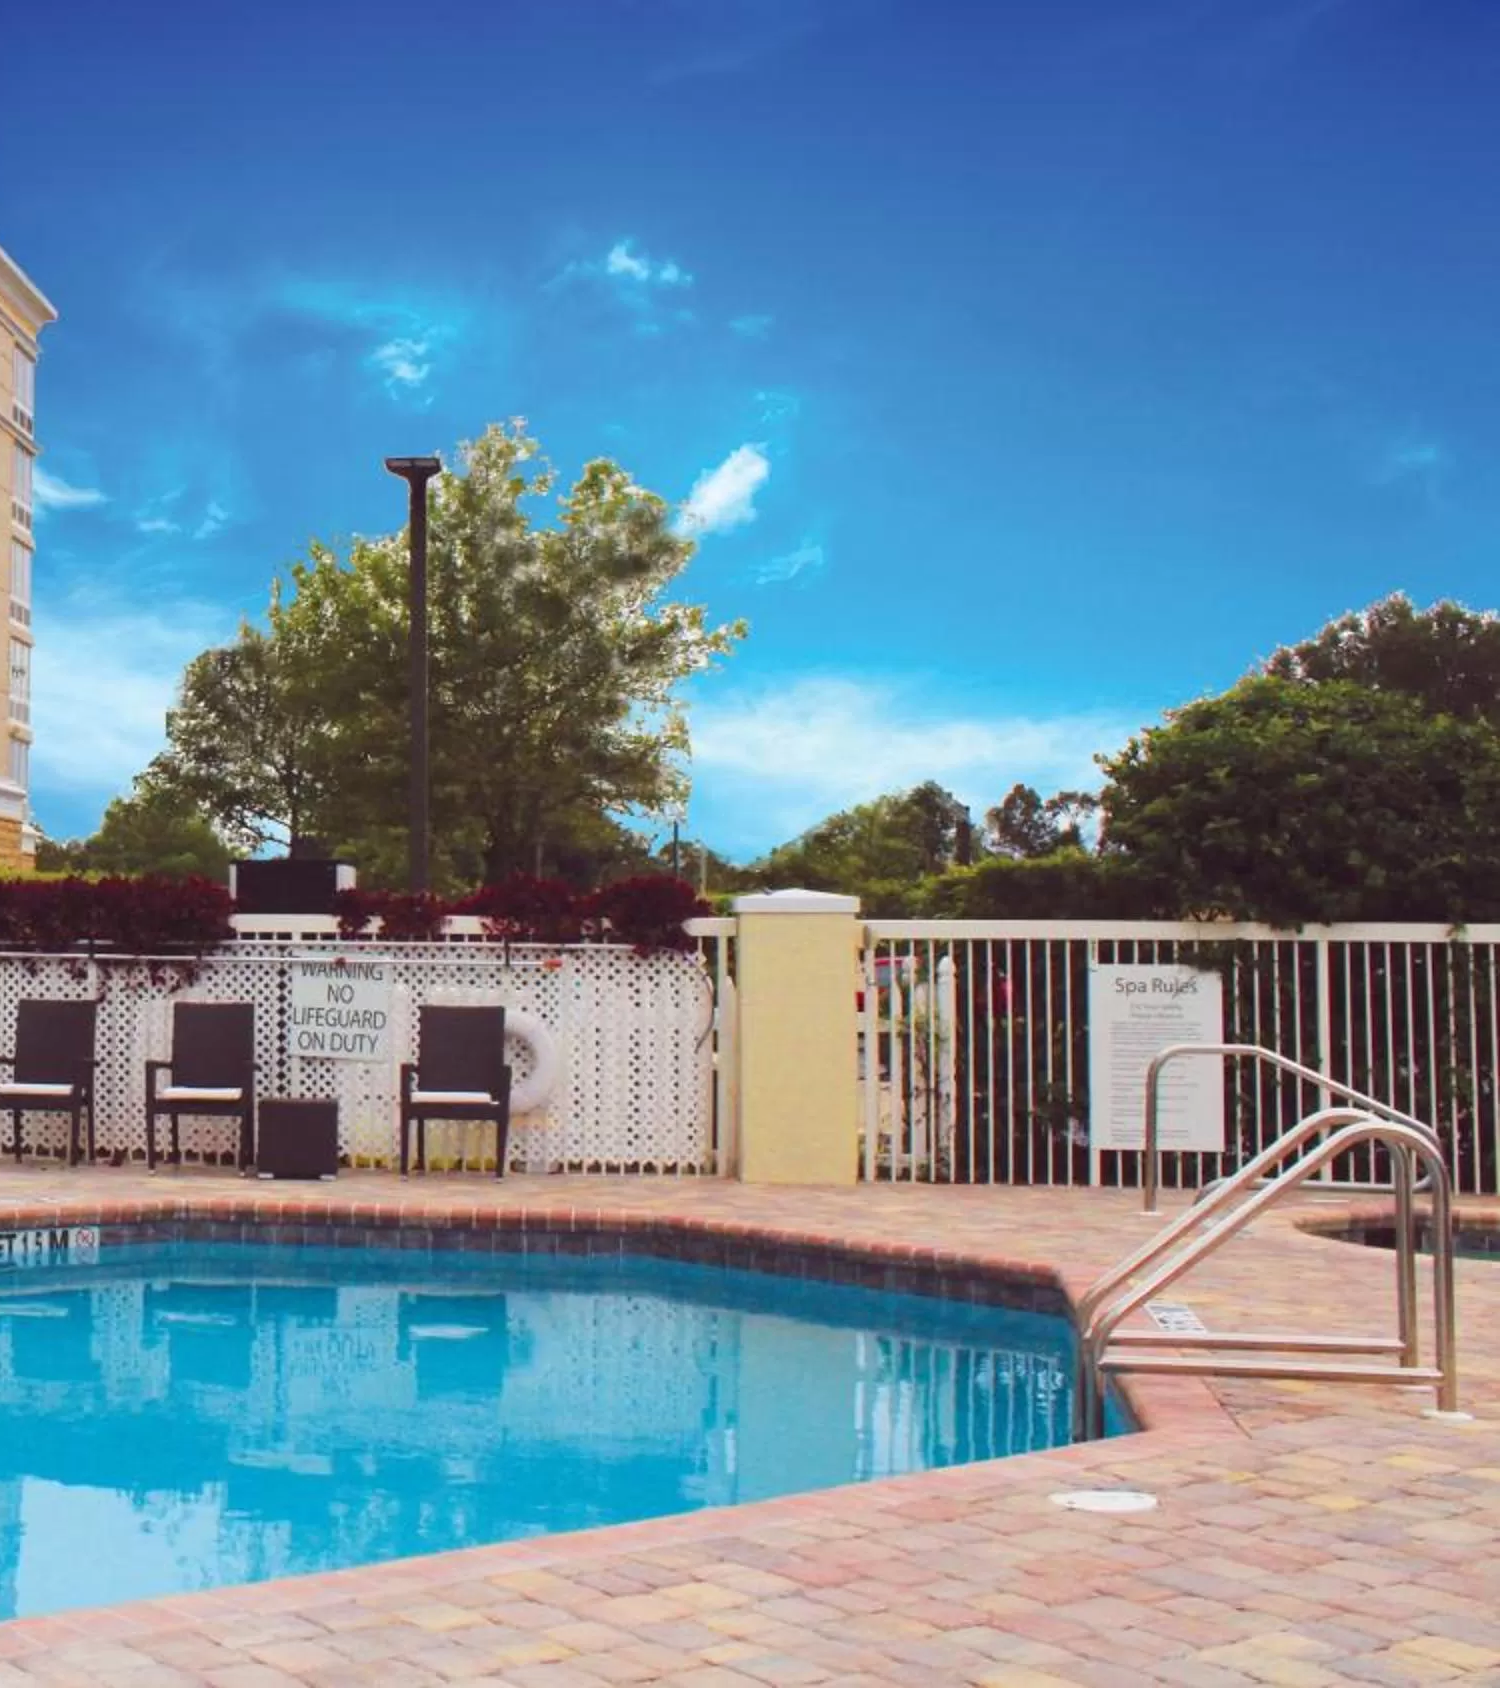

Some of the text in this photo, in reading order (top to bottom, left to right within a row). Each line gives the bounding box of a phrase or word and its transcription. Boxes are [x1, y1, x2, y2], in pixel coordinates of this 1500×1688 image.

[301, 962, 384, 981] WARNING
[327, 984, 355, 1004] NO
[1115, 977, 1198, 1000] Spa Rules
[293, 1007, 387, 1030] LIFEGUARD
[298, 1031, 379, 1053] ON DUTY
